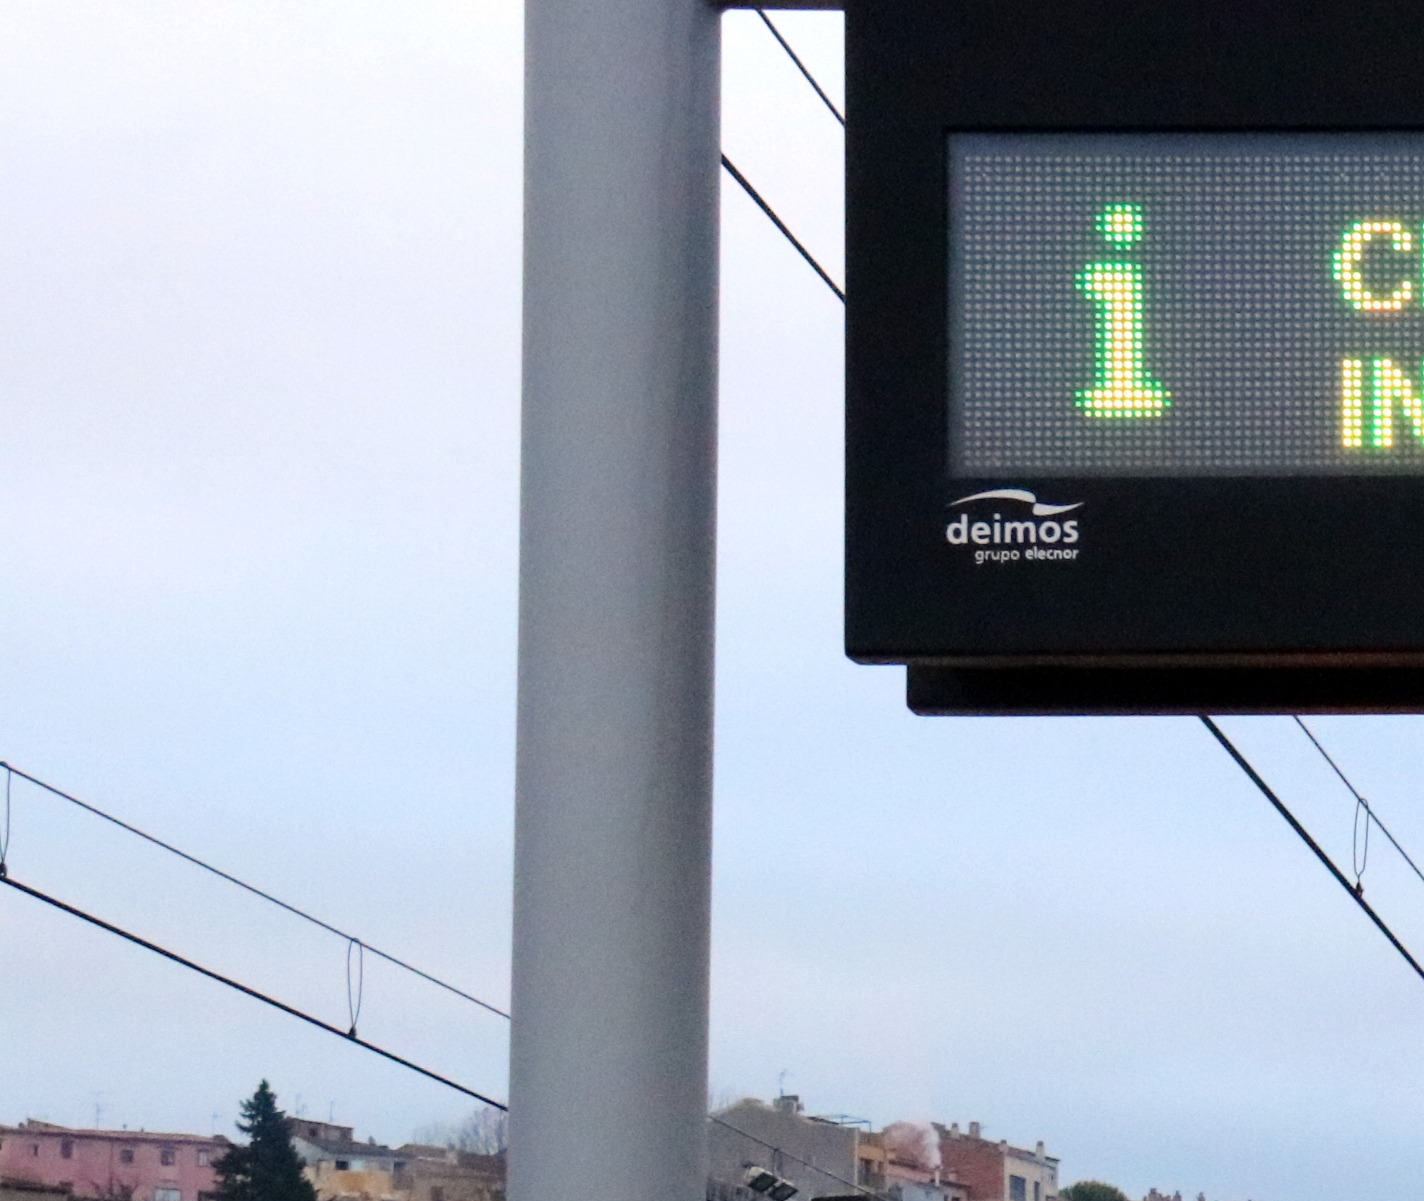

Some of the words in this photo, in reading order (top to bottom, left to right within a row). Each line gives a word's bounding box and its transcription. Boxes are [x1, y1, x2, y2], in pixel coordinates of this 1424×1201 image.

[946, 513, 1079, 544] deimos
[974, 550, 1020, 564] grupo
[1025, 546, 1079, 560] elecnor
